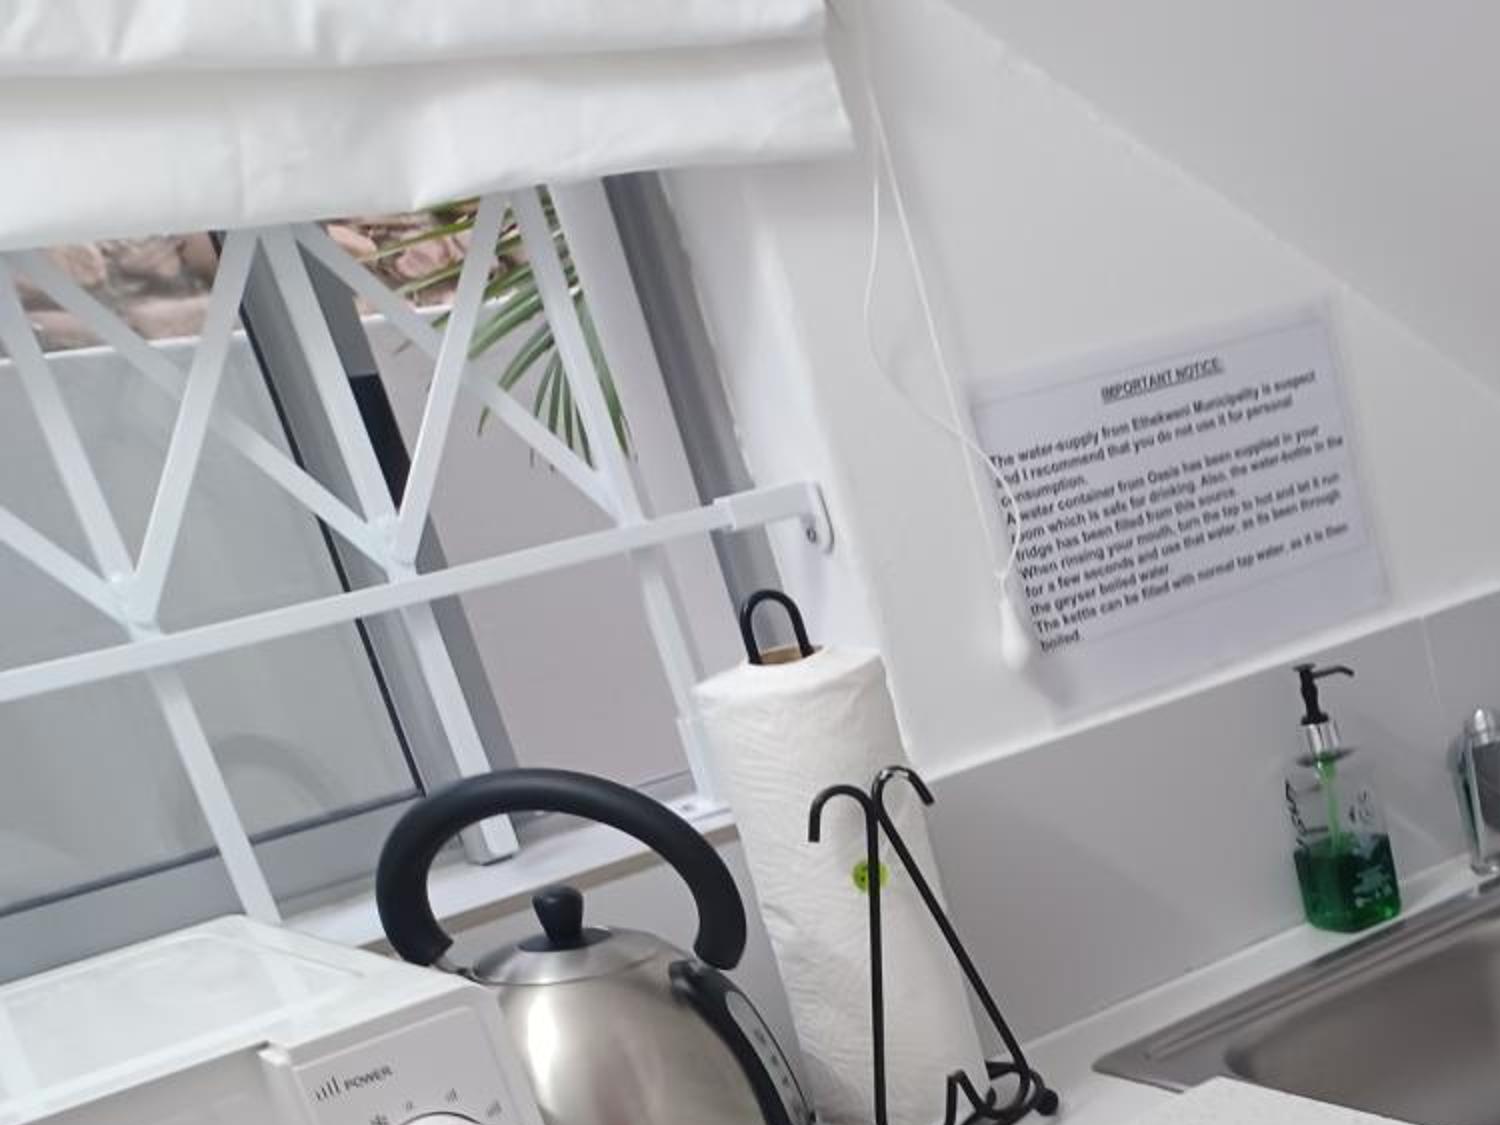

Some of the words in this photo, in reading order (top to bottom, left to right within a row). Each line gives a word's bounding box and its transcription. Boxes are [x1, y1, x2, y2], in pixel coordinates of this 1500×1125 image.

[989, 454, 1014, 468] The
[1102, 424, 1130, 439] from
[1193, 388, 1258, 413] Municipality
[1262, 384, 1271, 395] is
[1274, 370, 1315, 391] suspect
[1102, 369, 1173, 403] IMPORTANT
[1007, 512, 1017, 525] A
[1020, 503, 1053, 521] water
[1057, 485, 1115, 511] container
[1117, 477, 1145, 493] from
[1147, 466, 1180, 484] Oasis
[1182, 460, 1202, 473] has
[1204, 451, 1232, 467] been
[1234, 434, 1280, 459] supplied
[1282, 432, 1292, 444] in
[1296, 425, 1319, 442] your
[1031, 448, 1104, 478] recommend
[1108, 440, 1130, 457] that
[1133, 435, 1155, 453] you
[1157, 430, 1173, 444] do
[1175, 423, 1193, 438] not
[1195, 418, 1216, 432] use
[1218, 412, 1226, 426] it
[1228, 409, 1243, 423] for
[1246, 394, 1292, 421] personal
[1048, 513, 1086, 532] which
[1088, 510, 1100, 522] is
[1103, 500, 1128, 517] safe
[1130, 495, 1146, 507] for
[1230, 464, 1248, 478] the
[1314, 441, 1324, 452] in
[1327, 435, 1343, 448] the
[1015, 544, 1053, 562] fridge
[1056, 537, 1080, 550] has
[1082, 526, 1113, 542] been
[1115, 512, 1144, 531] filled
[1146, 506, 1174, 522] from
[1174, 500, 1196, 515] this
[1020, 562, 1059, 579] When
[1061, 548, 1105, 569] rinsing
[1108, 539, 1134, 558] your
[1178, 517, 1200, 532] turn
[1202, 510, 1220, 525] the
[1222, 505, 1240, 518] tap
[1242, 499, 1253, 511] to
[1255, 491, 1273, 505] hot
[1276, 483, 1295, 500] and
[1297, 479, 1310, 493] let
[1321, 471, 1340, 485] run
[1025, 584, 1043, 598] for
[1057, 575, 1081, 588] few
[1084, 557, 1135, 579] seconds
[1138, 547, 1159, 564] and
[1161, 542, 1181, 556] use
[1183, 532, 1205, 549] that
[1242, 518, 1255, 531] as
[1272, 504, 1298, 520] been
[1300, 487, 1340, 511] through
[1031, 601, 1051, 616] the
[1054, 588, 1096, 611] geyser
[1099, 573, 1137, 594] boiled
[1035, 618, 1060, 633] The
[1062, 607, 1097, 625] kettle
[1100, 599, 1123, 613] can
[1124, 593, 1139, 605] be
[1141, 580, 1170, 599] filled
[1172, 573, 1195, 589] with
[1198, 559, 1235, 580] normal
[1236, 554, 1254, 568] tap
[1290, 538, 1302, 550] as
[1313, 531, 1323, 541] is
[344, 1064, 393, 1091] POWER
